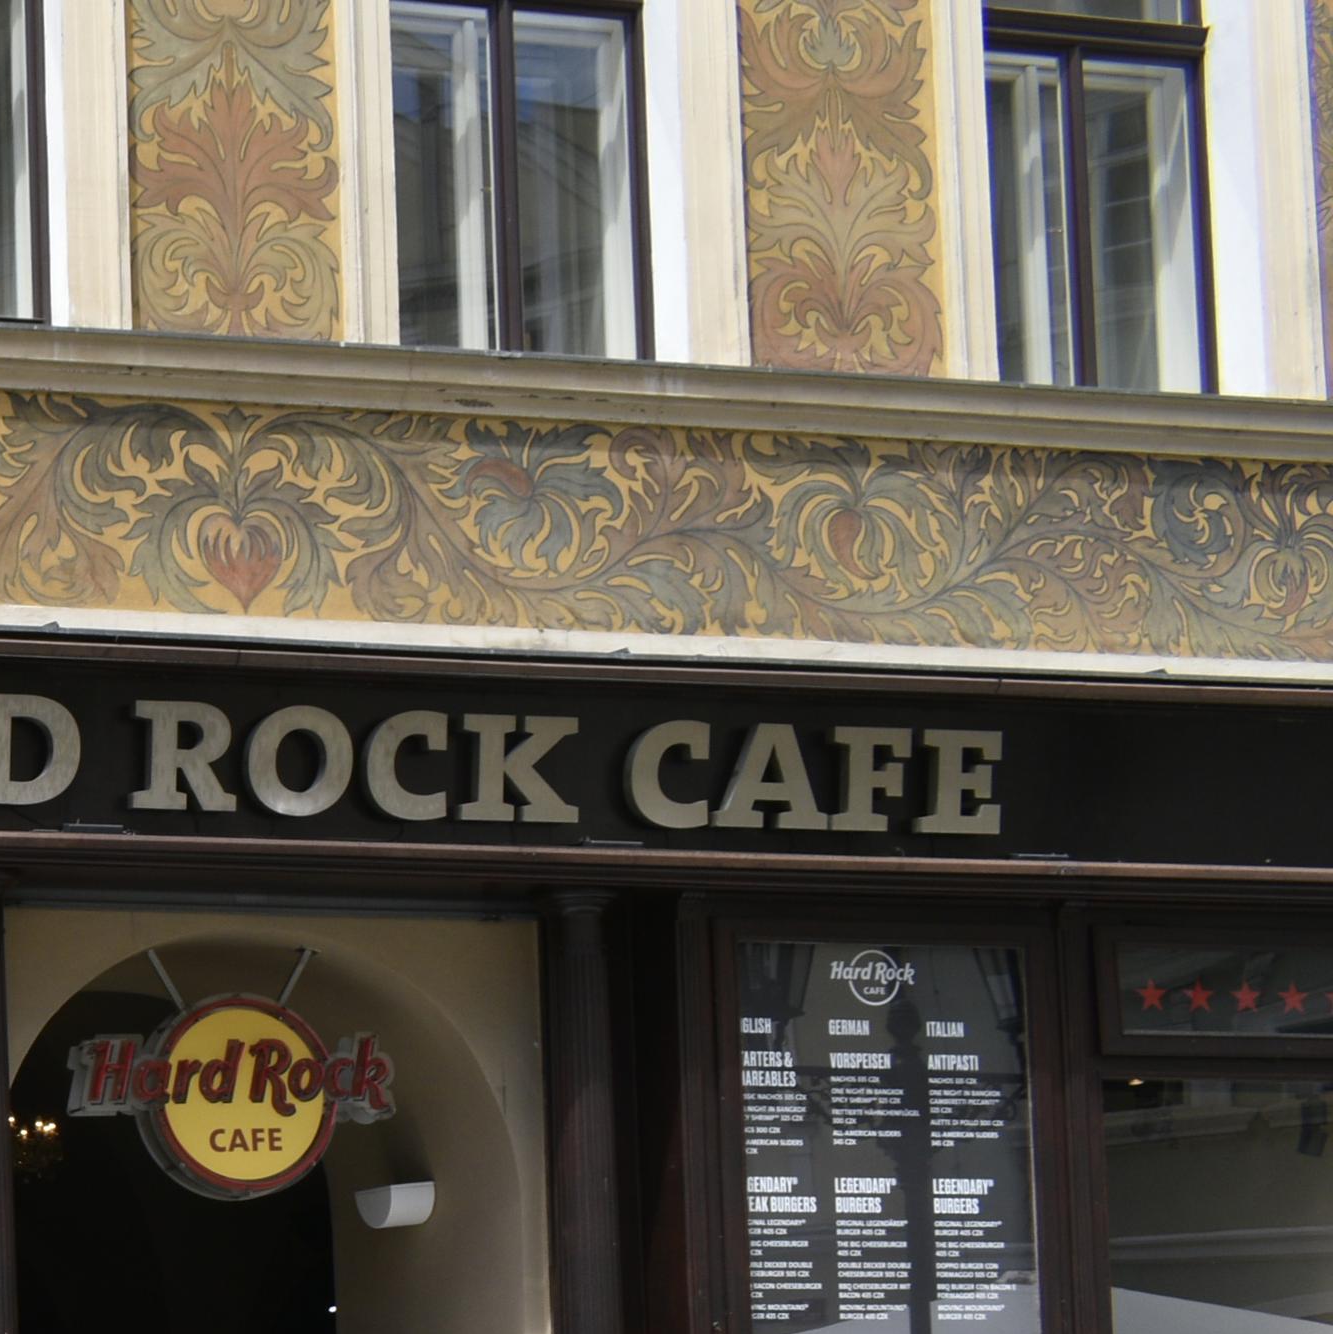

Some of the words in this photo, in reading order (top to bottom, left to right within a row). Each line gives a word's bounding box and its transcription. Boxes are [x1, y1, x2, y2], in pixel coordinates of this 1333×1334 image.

[129, 699, 580, 824] ROCK
[626, 718, 1003, 835] CAFE
[830, 961, 873, 980] Hard
[874, 961, 915, 985] Rock
[863, 986, 886, 995] CAFE
[828, 1019, 869, 1035] GERMAN
[926, 1021, 964, 1037] ITALIAN
[829, 1052, 890, 1069] VORSPEISEN
[927, 1054, 978, 1070] ANTIPASTI
[88, 1037, 245, 1105] Hard
[249, 1033, 394, 1116] Rock
[209, 1128, 283, 1152] CAFE
[769, 1195, 816, 1212] BURGERS
[835, 1196, 881, 1213] BURGERS
[933, 1197, 979, 1214] BURGERS
